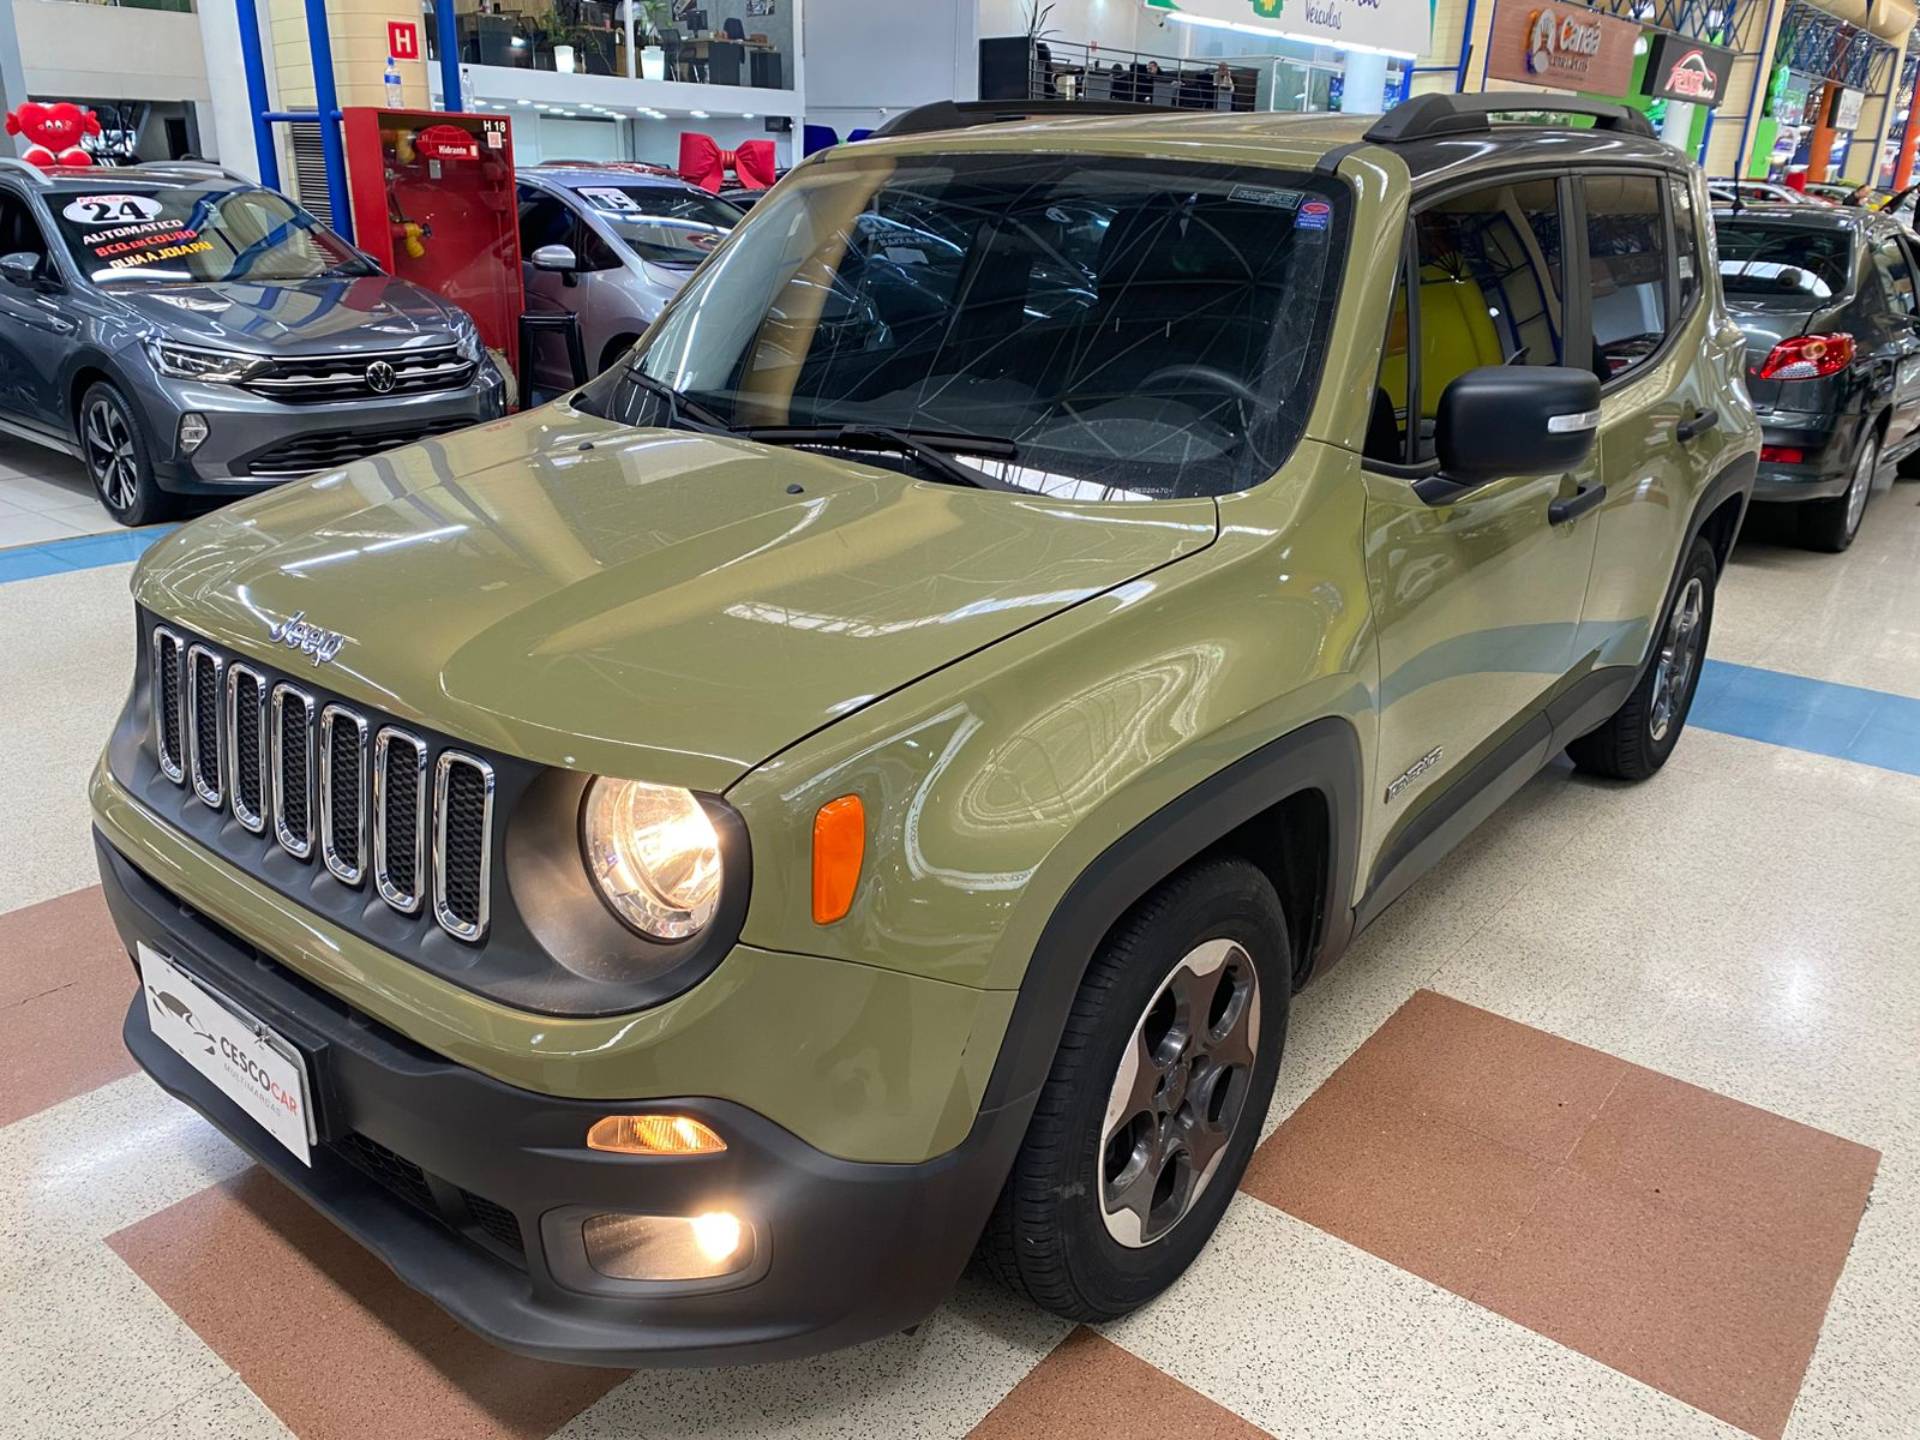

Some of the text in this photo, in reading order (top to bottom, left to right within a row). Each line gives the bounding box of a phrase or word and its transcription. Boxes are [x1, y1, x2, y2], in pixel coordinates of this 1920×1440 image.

[395, 28, 412, 53] H
[483, 120, 506, 132] H 18
[438, 144, 467, 156] Hidrante
[82, 201, 150, 222] 24
[83, 219, 185, 246] AUTOMATICO
[109, 253, 148, 270] OLHA
[147, 251, 160, 263] A
[159, 244, 194, 260] JOIA
[268, 610, 344, 668] Jeep
[220, 1036, 298, 1116] CESCOCAR
